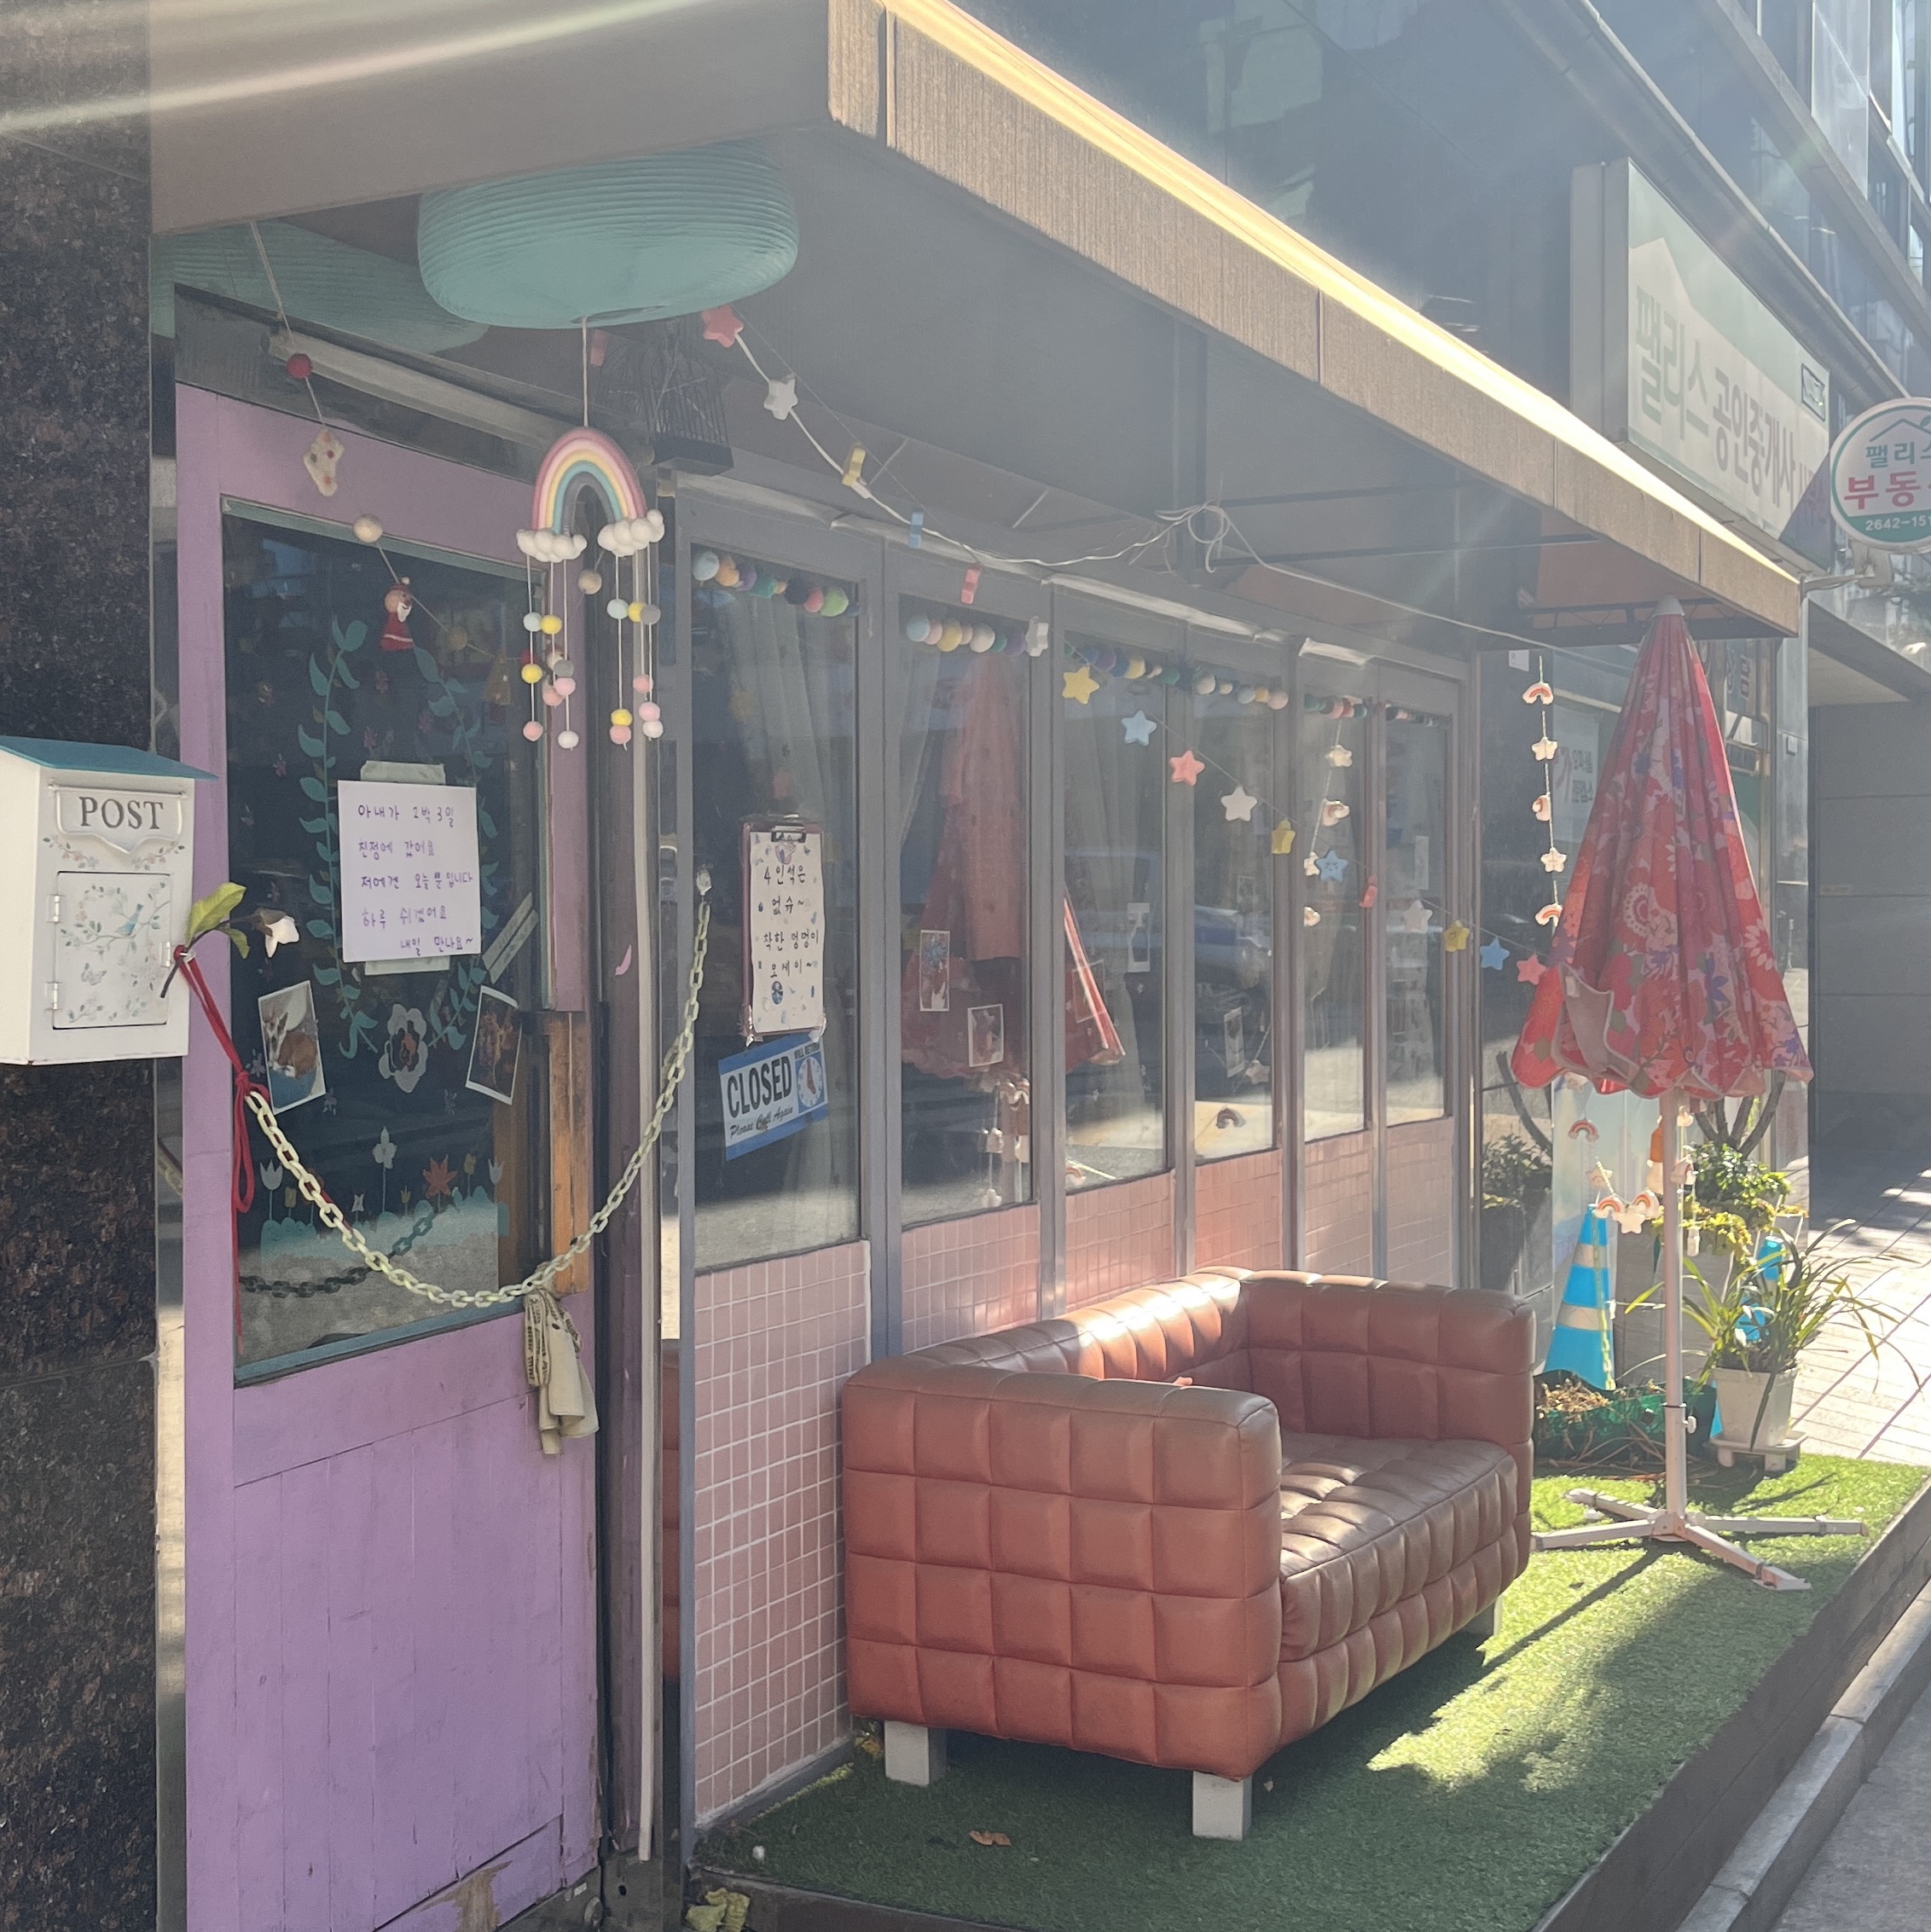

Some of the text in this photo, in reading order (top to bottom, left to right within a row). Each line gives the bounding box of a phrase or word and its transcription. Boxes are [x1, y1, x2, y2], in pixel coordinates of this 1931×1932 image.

[1636, 284, 1709, 442] 팰리스
[1713, 366, 1796, 513] 공인중개사
[1844, 471, 1931, 510] 부동
[78, 796, 164, 830] POST
[357, 804, 454, 827] 아내가 2박 3일
[358, 838, 434, 860] 친정에 갔어요
[361, 876, 399, 890] 저에겐
[362, 905, 446, 929] 하루 쉬겠어요
[401, 937, 420, 956] 내일
[728, 1056, 792, 1118] CLOSED
[730, 1106, 793, 1139] Please Call Again
